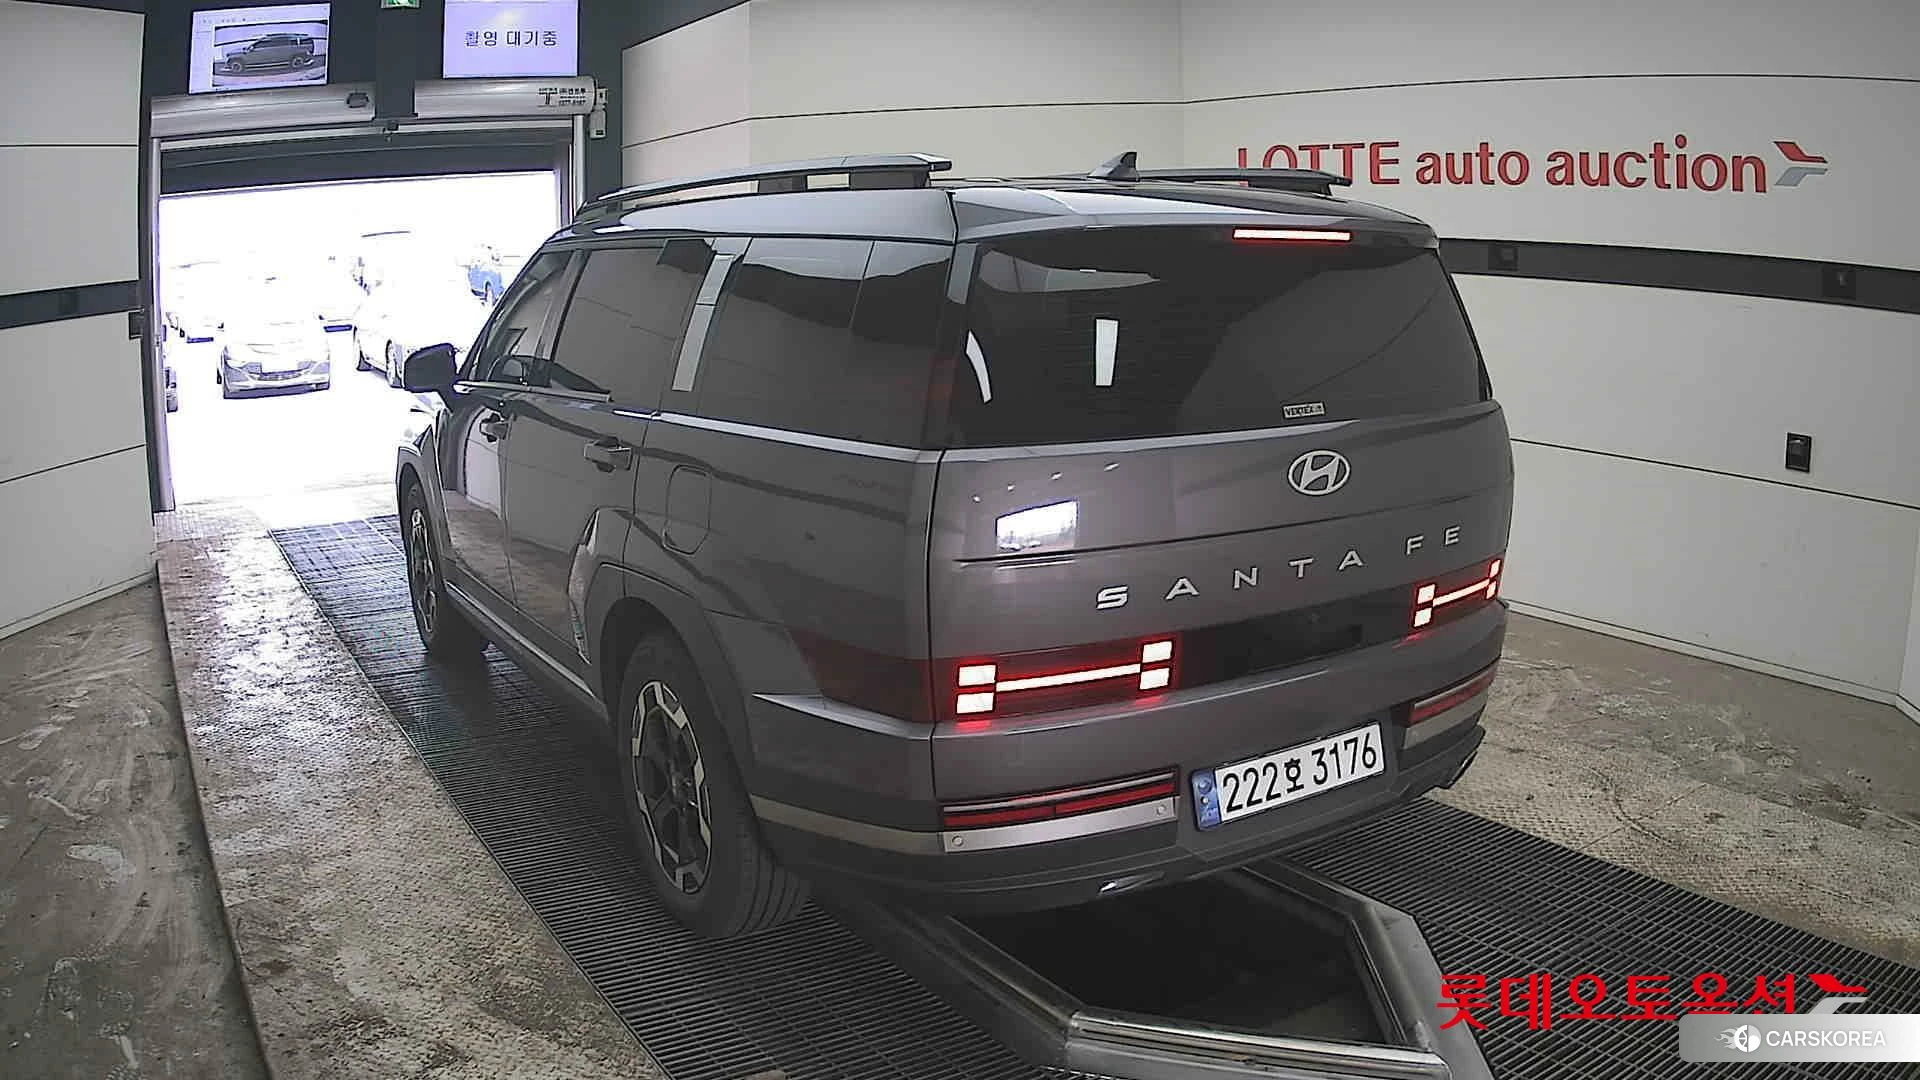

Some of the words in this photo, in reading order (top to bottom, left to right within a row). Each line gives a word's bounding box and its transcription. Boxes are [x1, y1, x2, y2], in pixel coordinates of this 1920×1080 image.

[506, 30, 557, 46] 대기중
[1416, 142, 1530, 186] auto
[1546, 135, 1768, 193] auction
[1096, 549, 1364, 610] SANTA
[1404, 526, 1461, 556] FE
[1311, 732, 1377, 786] 3176
